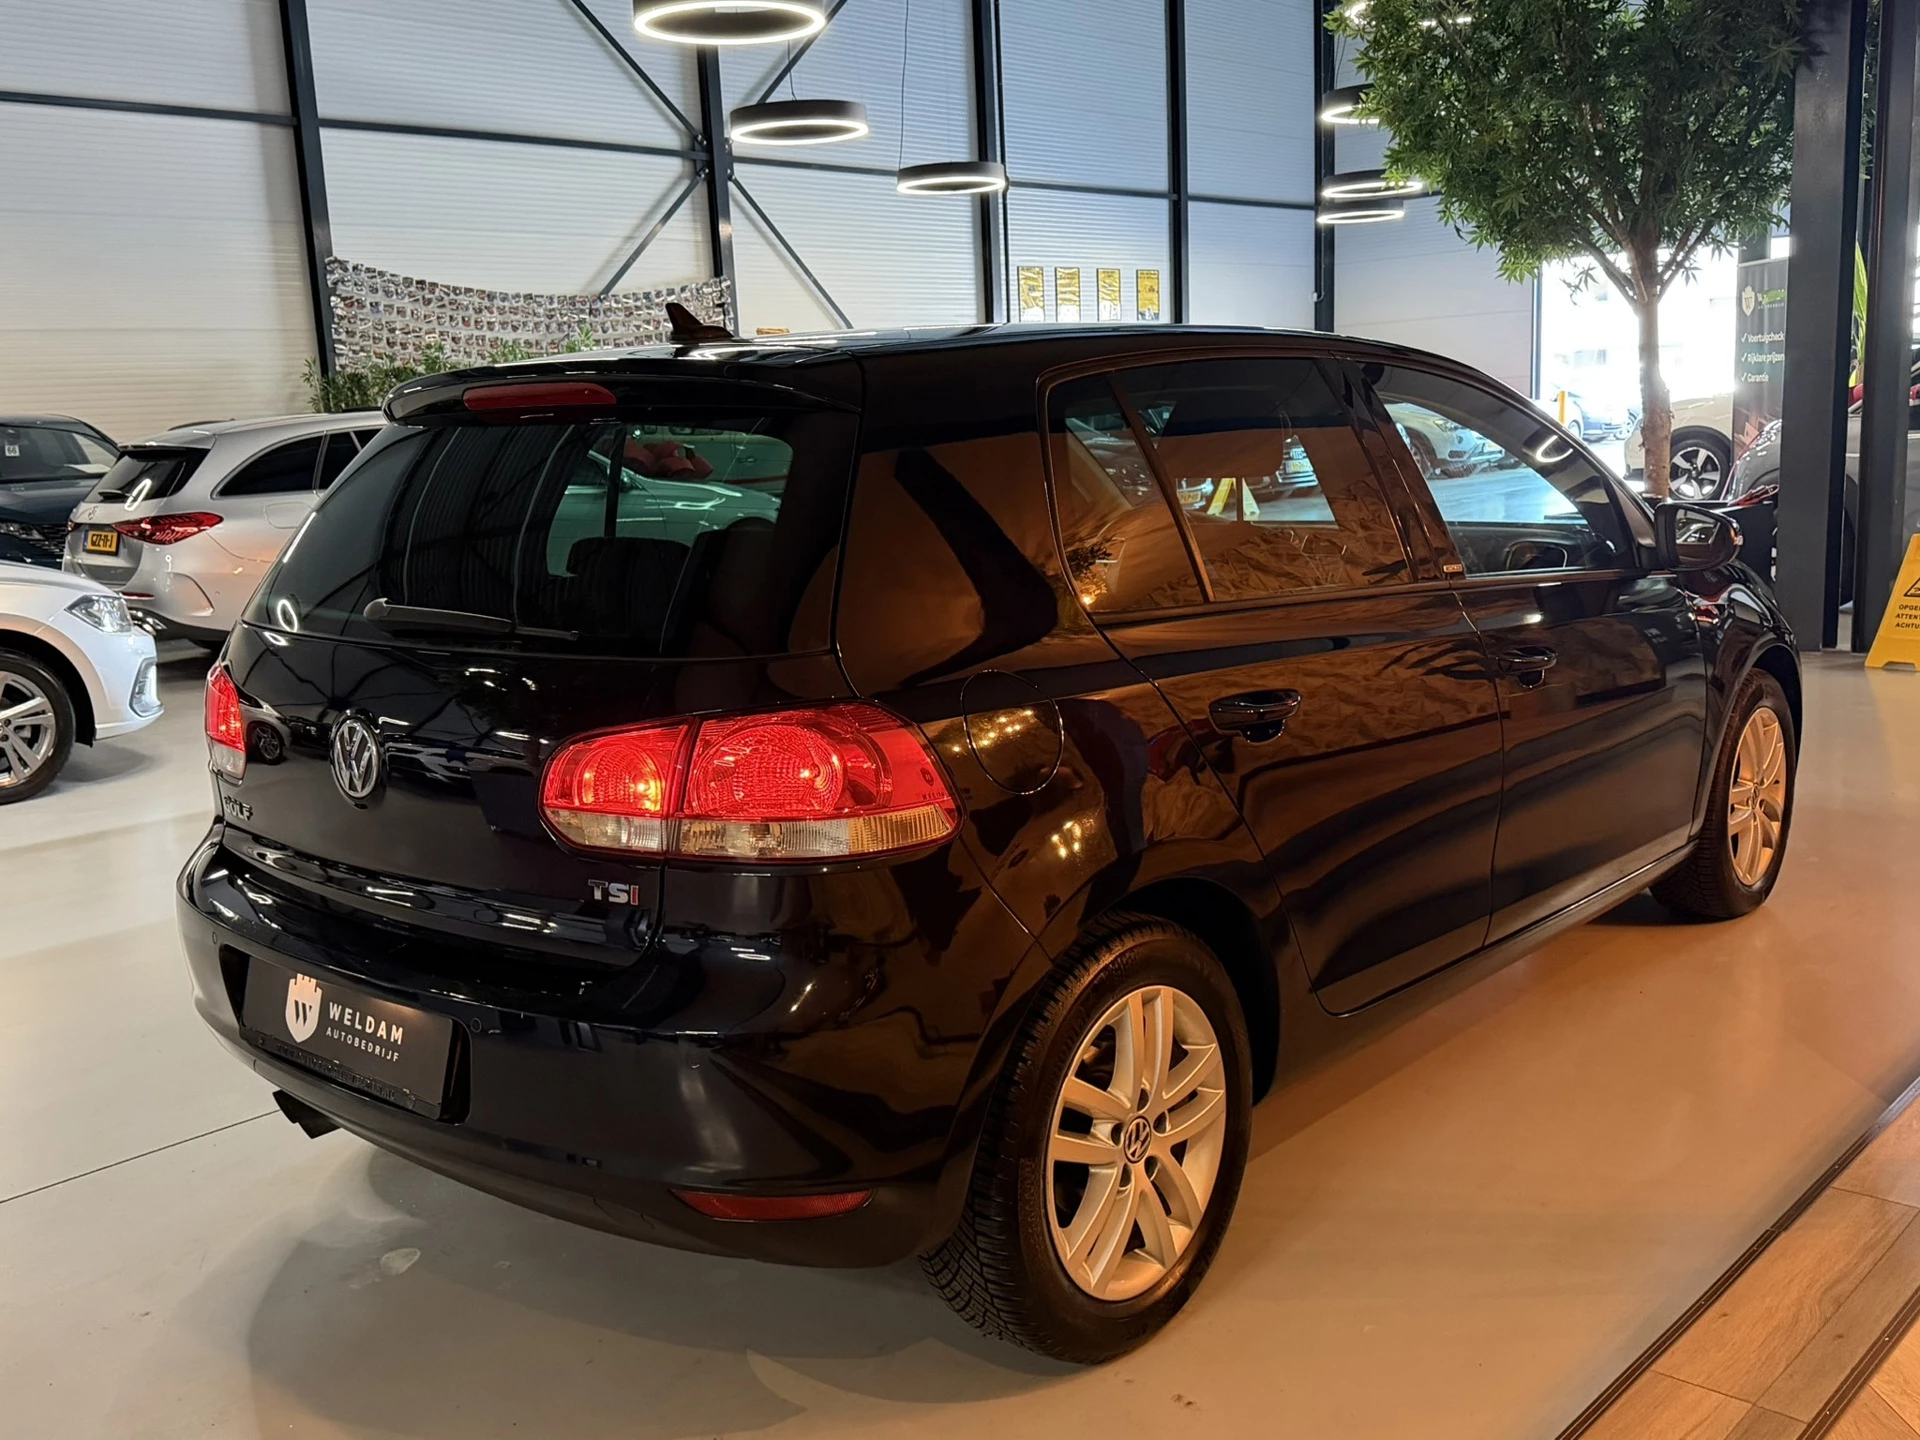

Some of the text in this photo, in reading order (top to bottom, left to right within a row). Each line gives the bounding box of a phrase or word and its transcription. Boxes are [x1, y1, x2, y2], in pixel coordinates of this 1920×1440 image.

[588, 879, 639, 906] TSI
[328, 1001, 405, 1046] WELDAM
[325, 1026, 400, 1063] AUTOBEDRIJF
